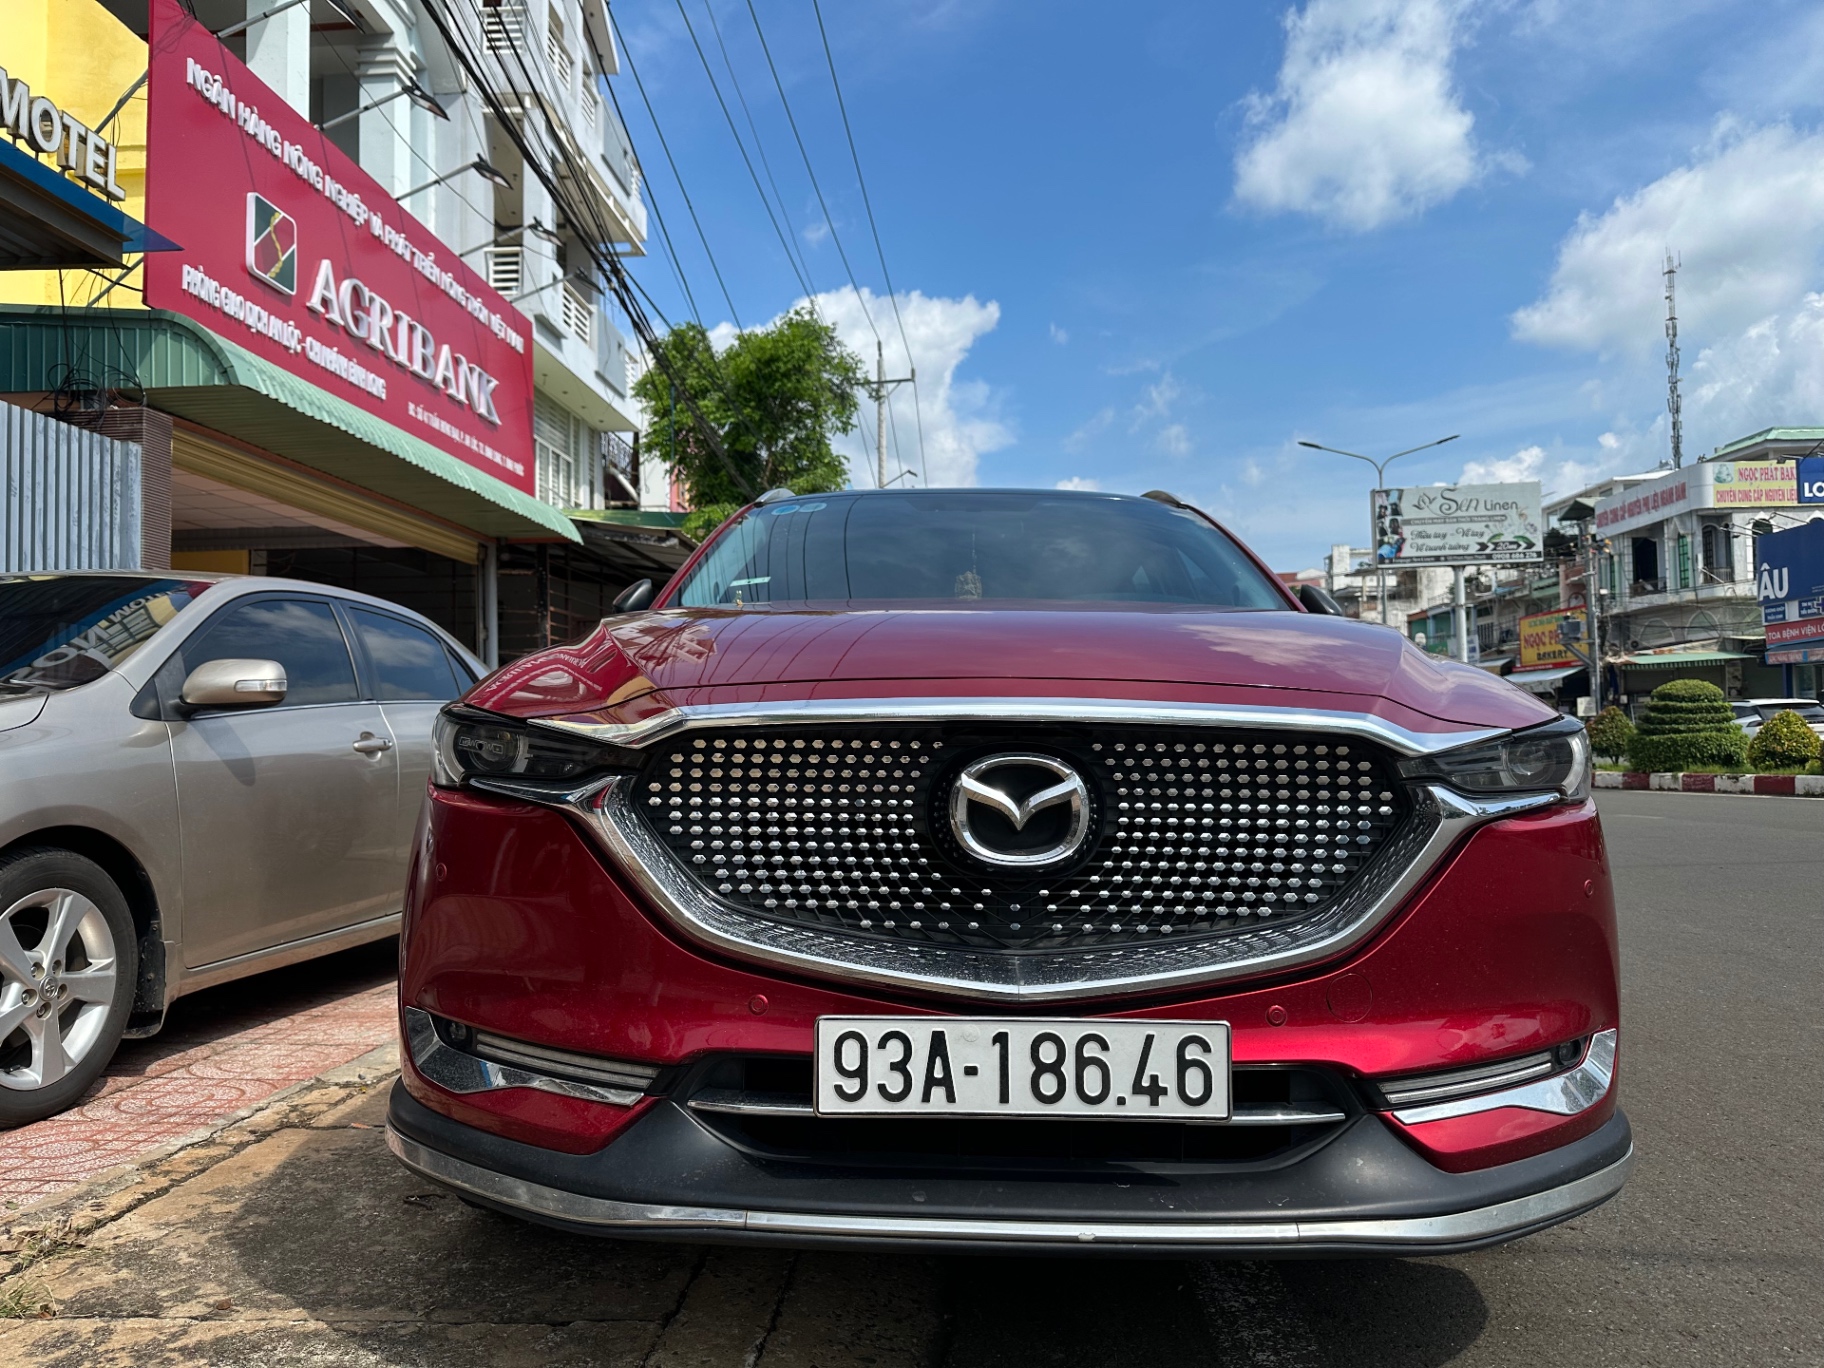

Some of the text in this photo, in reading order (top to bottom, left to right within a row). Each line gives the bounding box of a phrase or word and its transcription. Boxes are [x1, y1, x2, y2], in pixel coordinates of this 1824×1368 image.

[0, 66, 125, 201] MOTEL
[187, 57, 236, 119] NGÂN
[238, 102, 282, 158] HÀNG
[283, 141, 323, 191] NÔNG
[324, 175, 369, 226] NGHIỆP
[369, 211, 384, 240] VÀ
[182, 264, 220, 308] PHÒNG
[220, 287, 245, 321] GIAO
[245, 301, 268, 335] DỊCH
[306, 259, 502, 425] AGRIBANK
[1738, 463, 1796, 486] NGỌC PHÁT BAK
[1804, 482, 1824, 497] LO
[1439, 488, 1518, 516] Sen Linen
[1716, 487, 1737, 502] CHUYÊN
[1760, 562, 1789, 600] ÂU
[1768, 631, 1781, 640] TOA
[1782, 628, 1800, 639] BỆNH
[1801, 624, 1816, 636] VIỆN
[1537, 650, 1568, 661] BAKERY
[833, 1030, 1213, 1107] 93A-186.46
